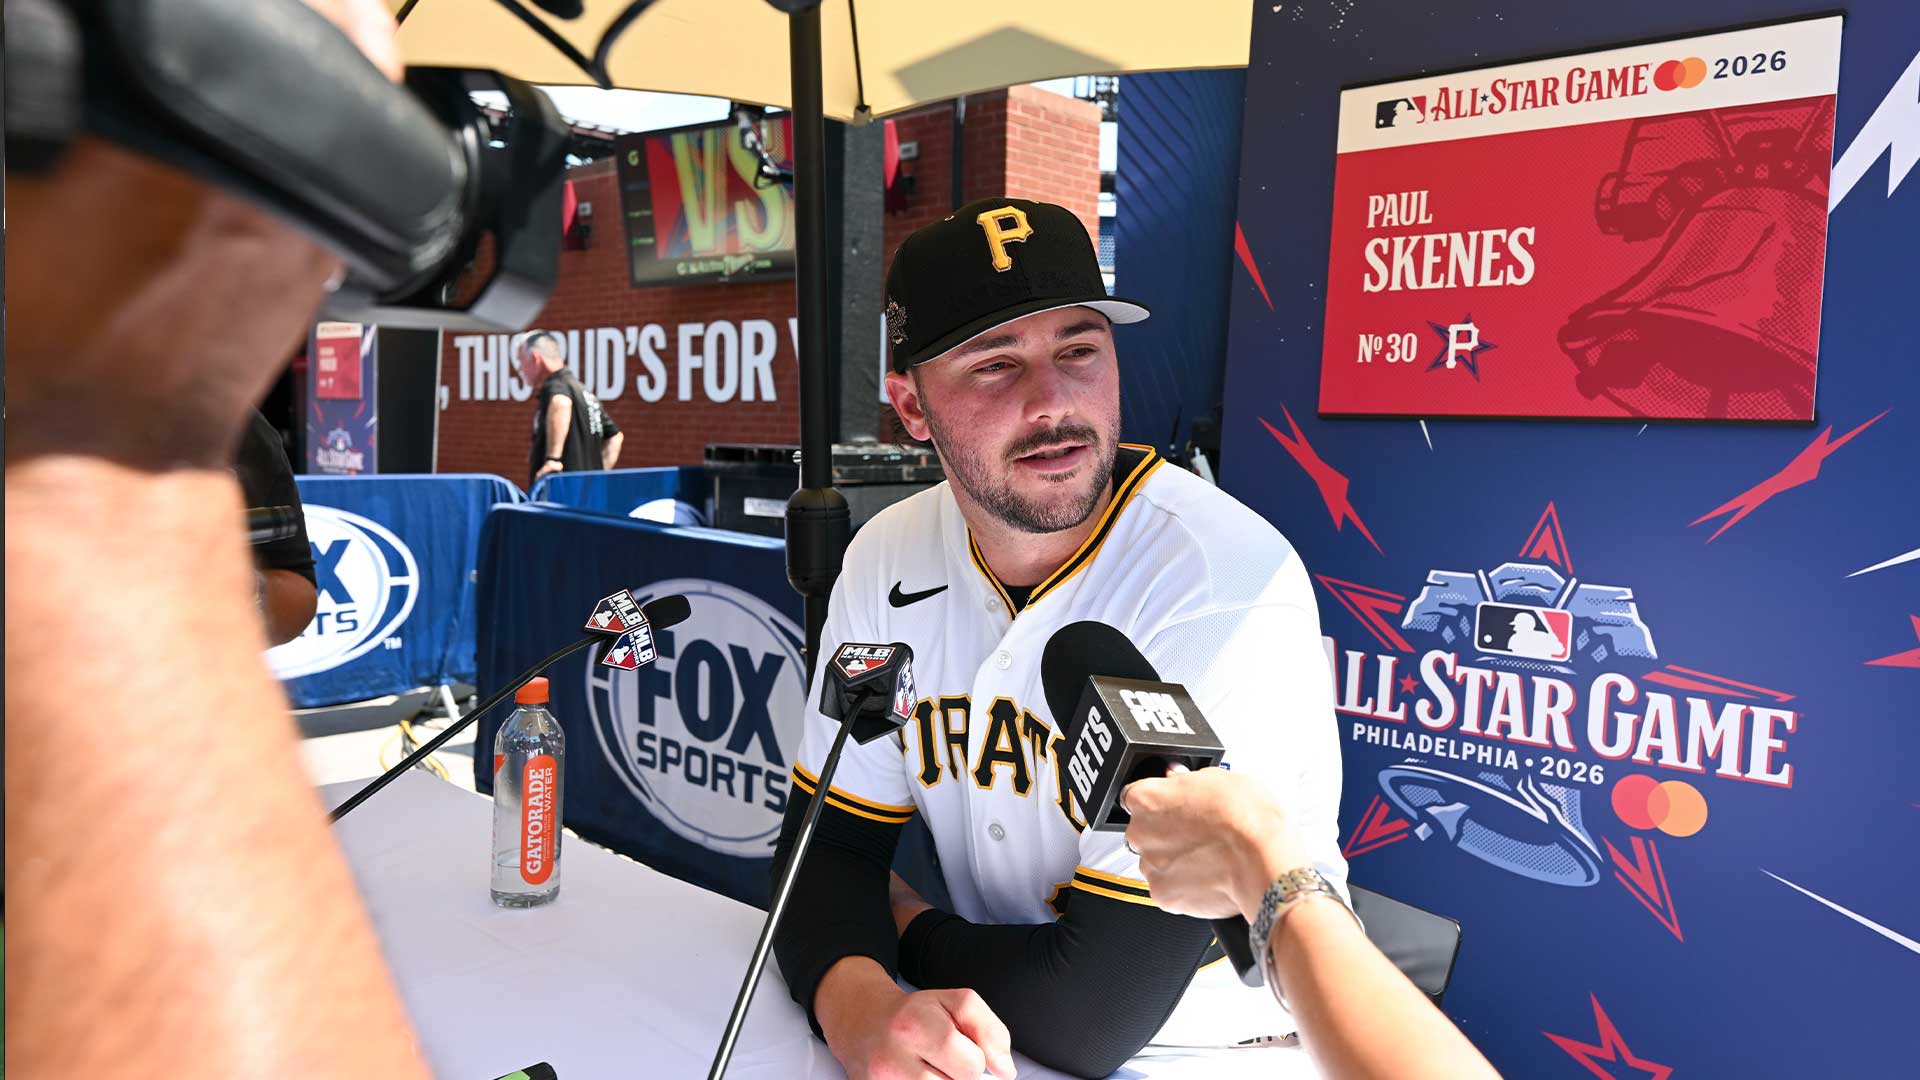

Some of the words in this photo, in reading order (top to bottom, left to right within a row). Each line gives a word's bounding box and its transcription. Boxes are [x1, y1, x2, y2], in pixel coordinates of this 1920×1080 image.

[1565, 63, 1650, 105] GAME
[1713, 50, 1788, 80] 2026
[671, 120, 785, 256] VS
[1367, 189, 1433, 229] PAUL
[976, 205, 1034, 272] P
[1363, 226, 1536, 293] SKENES
[455, 333, 533, 402] THIS
[551, 322, 668, 402] UD'S
[678, 318, 778, 403] FOR
[1386, 332, 1418, 363] 30
[1445, 321, 1480, 369] P
[612, 592, 643, 626] MLB
[633, 626, 655, 663] MLB
[840, 653, 887, 661] NETWORK
[843, 646, 891, 658] MLB
[637, 628, 787, 769] FOX
[1586, 671, 1797, 789] GAME
[636, 729, 789, 815] SPORTS
[1067, 705, 1113, 804] BETS
[1352, 721, 1519, 770] PHILADELPHIA
[1540, 754, 1605, 787] 2026
[526, 767, 545, 875] GATORADE
[544, 766, 553, 812] WATER
